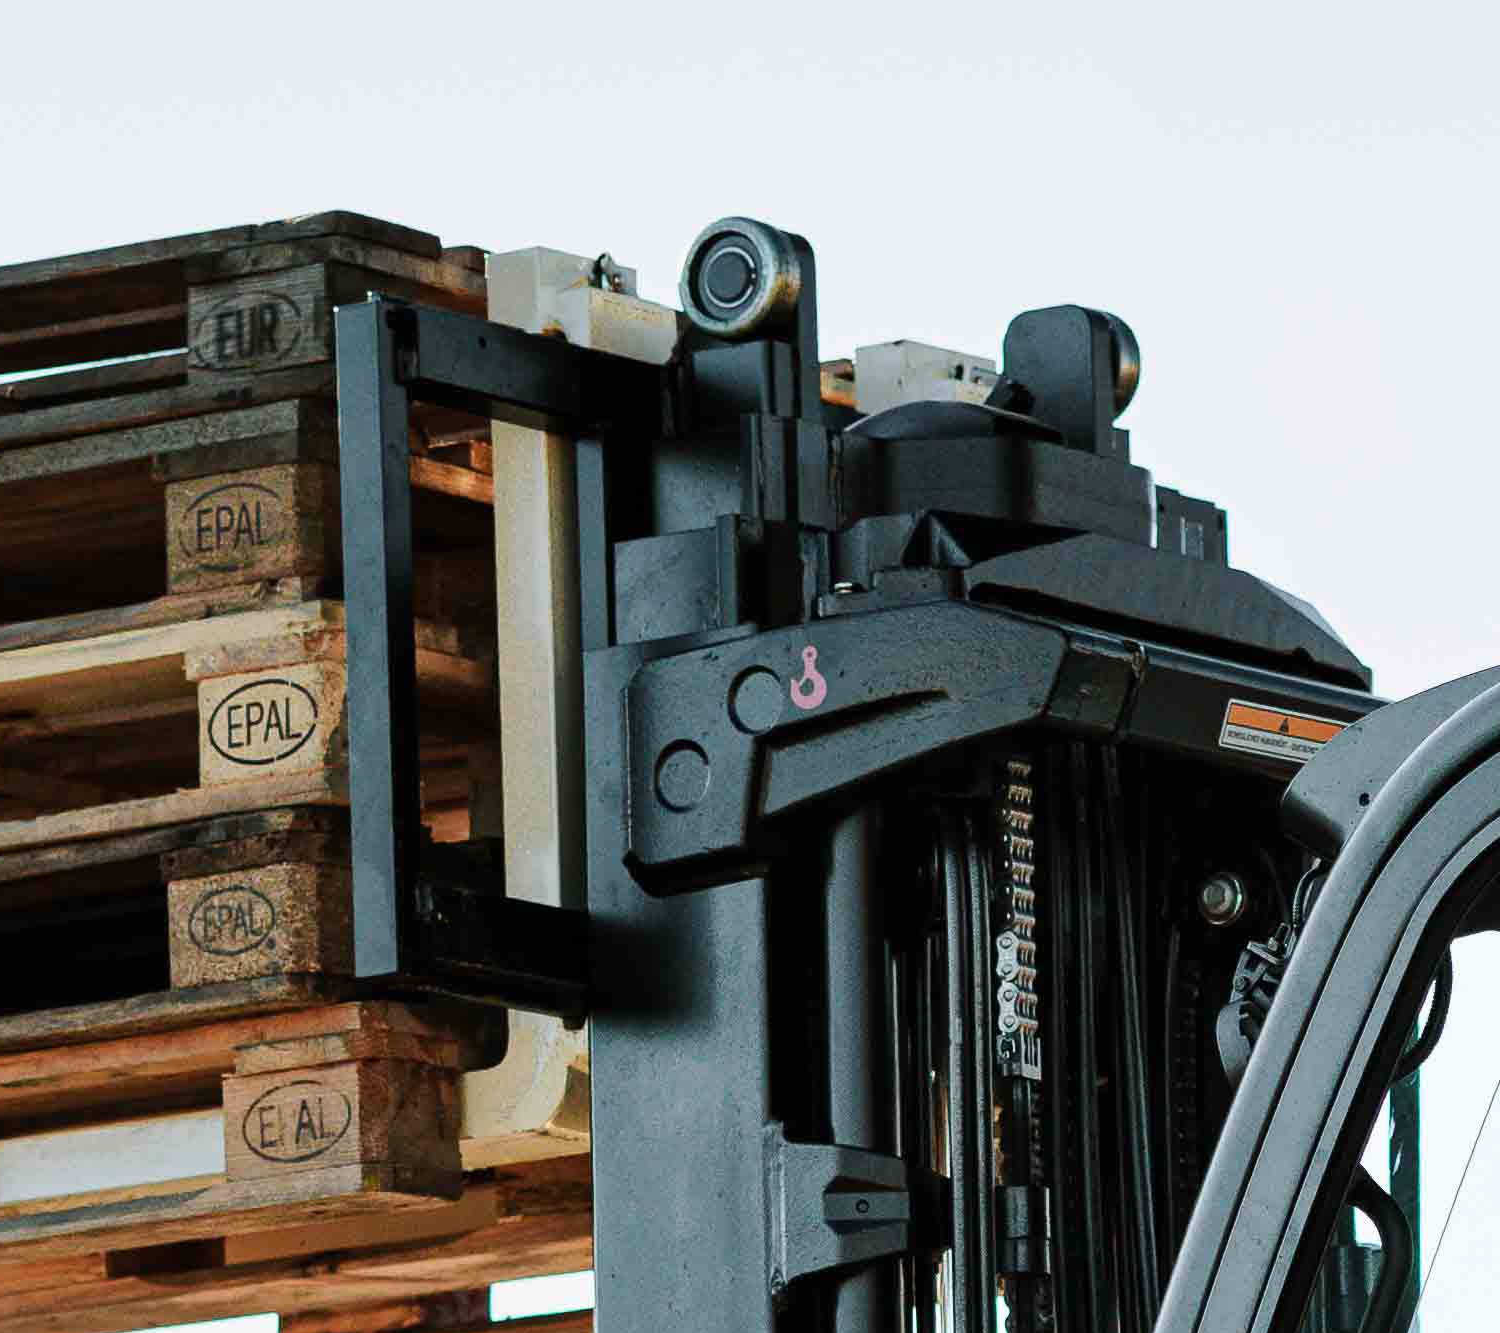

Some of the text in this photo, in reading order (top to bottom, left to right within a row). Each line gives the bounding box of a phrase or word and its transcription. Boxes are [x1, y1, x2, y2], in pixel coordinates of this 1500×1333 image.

[212, 302, 278, 361] EUR
[196, 499, 269, 554] EPAL
[227, 699, 302, 748] EPAL
[203, 899, 264, 943] EPAL
[259, 1100, 336, 1148] EAL
